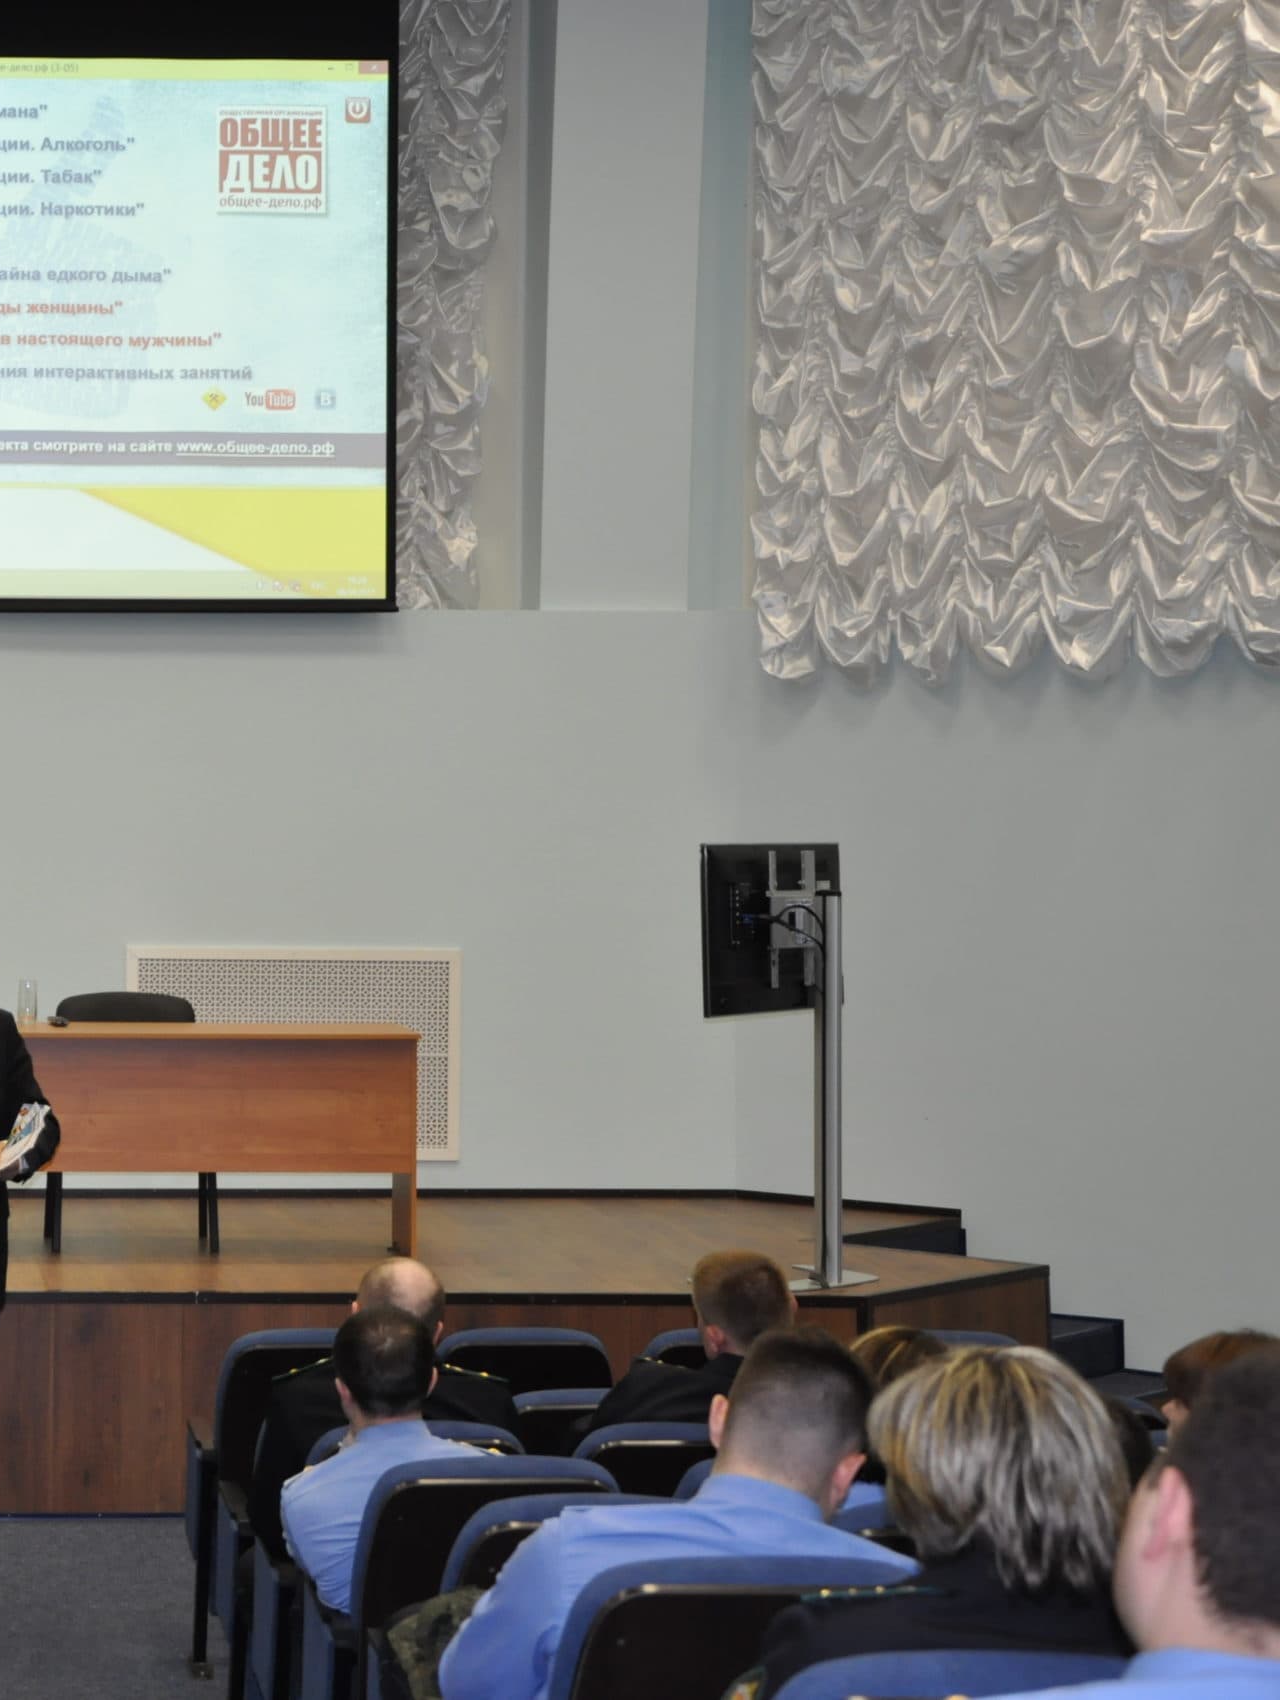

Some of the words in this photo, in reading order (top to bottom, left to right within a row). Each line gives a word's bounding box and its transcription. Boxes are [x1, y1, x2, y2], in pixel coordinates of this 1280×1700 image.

[220, 118, 322, 150] ОБЩЕЕ
[40, 137, 135, 152] Алкоголь"
[40, 169, 102, 184] Табак"
[223, 154, 318, 193] ДЕЛО
[40, 201, 144, 220] Наркотики"
[220, 195, 322, 210] общее-дело.рф
[47, 269, 107, 283] едкого
[112, 268, 171, 284] дыма"
[27, 301, 123, 316] женщины"
[17, 333, 123, 348] настоящего
[128, 332, 222, 350] мужчины"
[33, 366, 174, 382] интерактивных
[179, 364, 252, 381] занятий
[245, 389, 296, 410] YouTube
[33, 441, 104, 454] смотрите
[108, 442, 125, 452] на
[130, 440, 172, 453] сайте
[176, 440, 335, 456] www.общее-дело.рф
